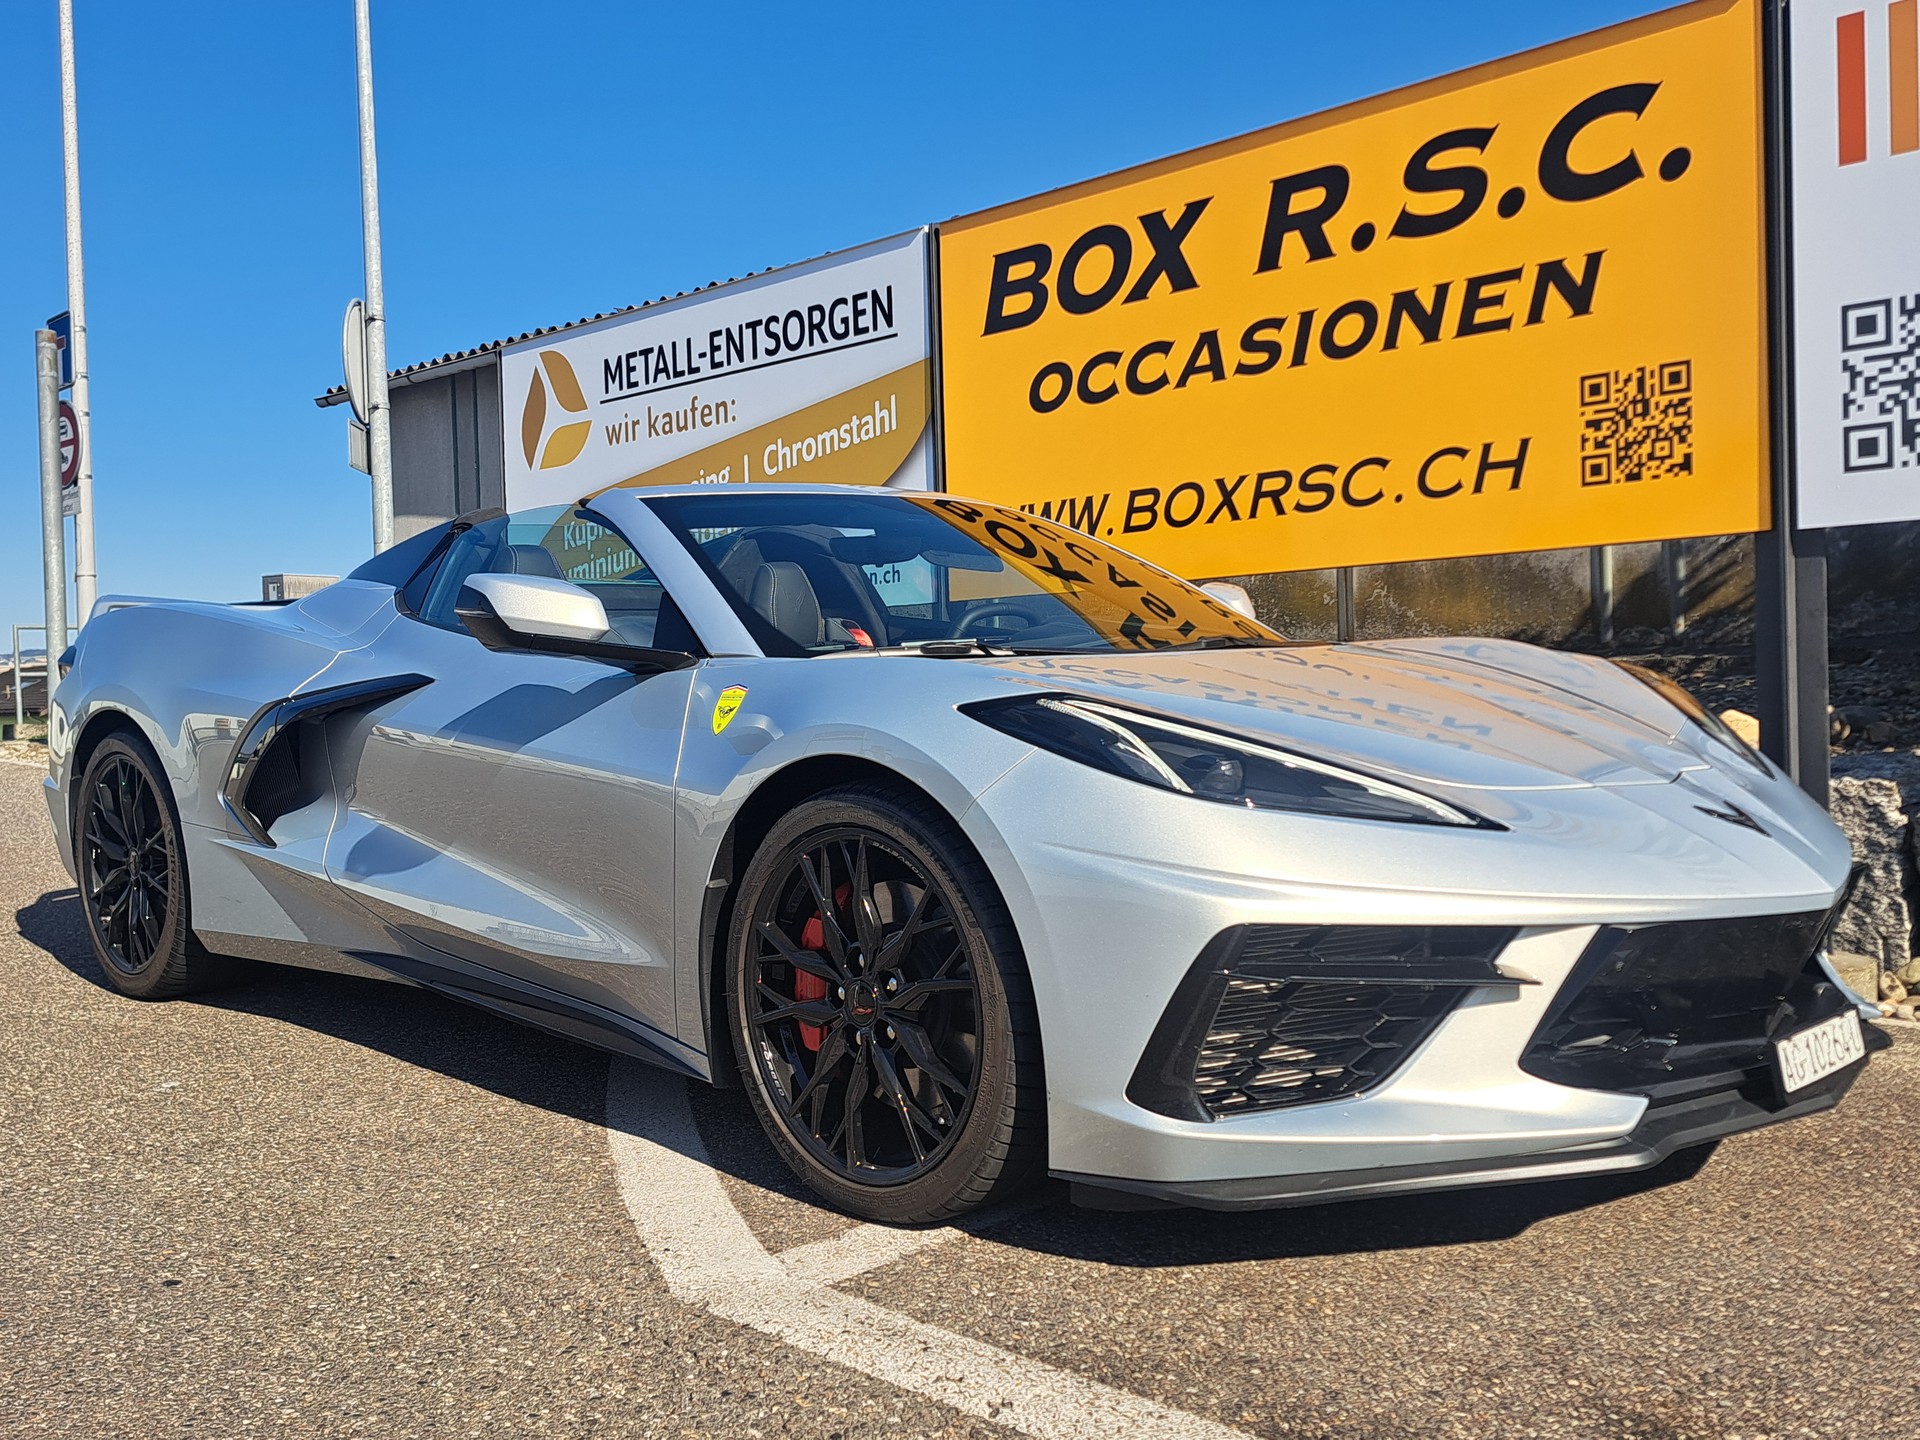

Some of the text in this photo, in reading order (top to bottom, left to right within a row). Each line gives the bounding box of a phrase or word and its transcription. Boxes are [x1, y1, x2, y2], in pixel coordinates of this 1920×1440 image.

[980, 81, 1693, 338] BOX R.S.C.
[603, 284, 895, 395] METALL-ENTSORGEN
[1028, 249, 1608, 414] OCCASIONEN
[605, 395, 738, 447] wir kaufen:
[691, 394, 897, 485] ing Chromstahl
[1019, 437, 1533, 538] W.BOXRSC.CH
[871, 841, 925, 880] CORVETTE
[760, 1041, 785, 1097] FORGED
